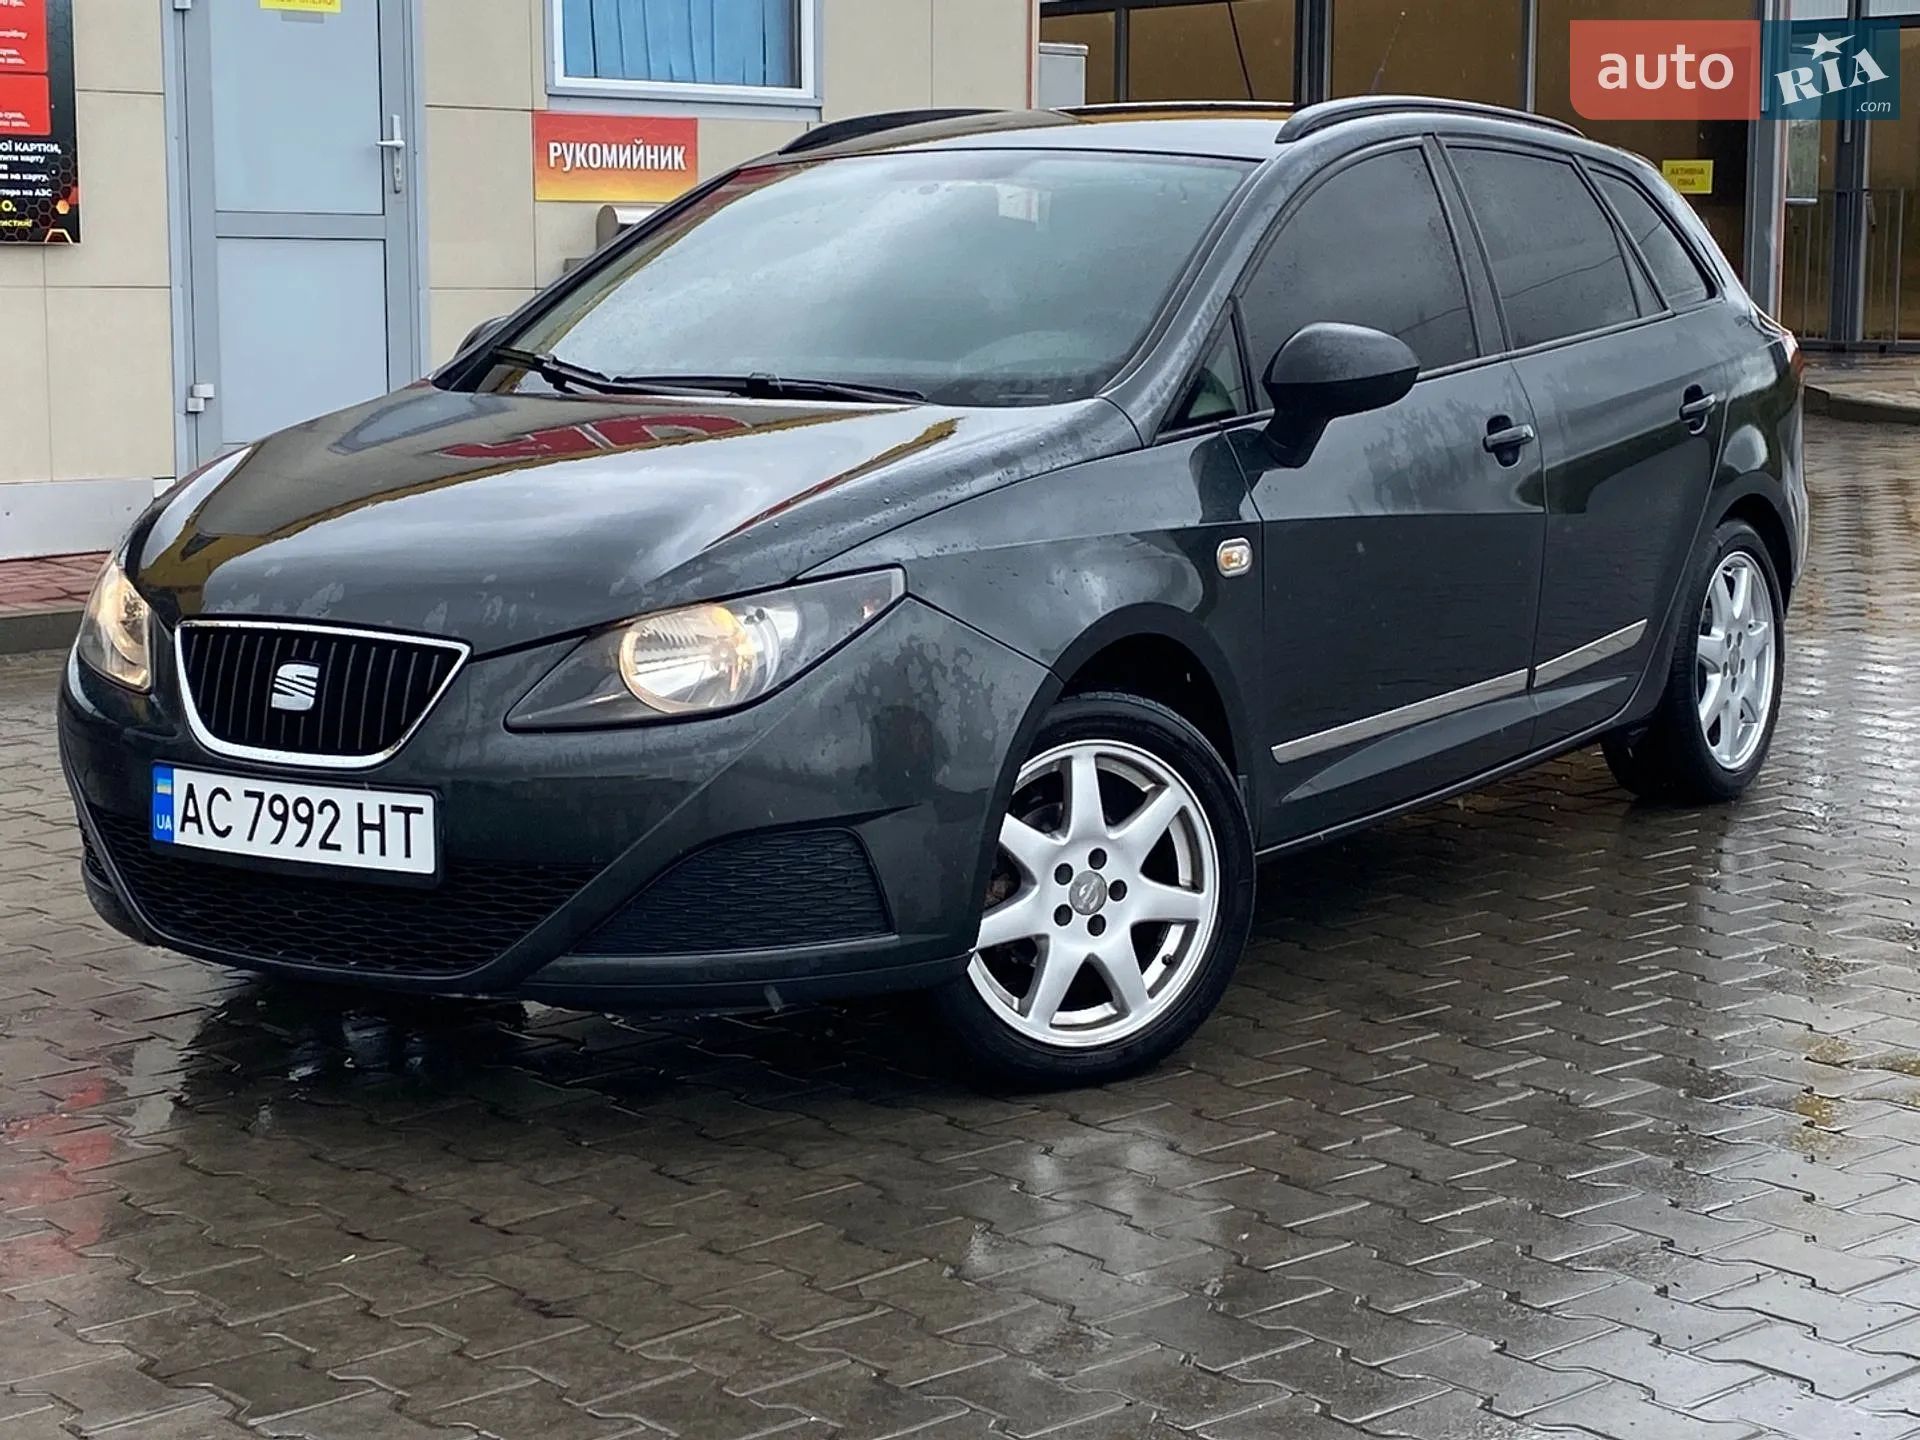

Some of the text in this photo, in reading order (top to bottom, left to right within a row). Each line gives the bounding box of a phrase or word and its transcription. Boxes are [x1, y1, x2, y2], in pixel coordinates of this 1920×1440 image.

[549, 138, 687, 172] РУКОМИЙНИК
[156, 813, 172, 831] UA
[179, 783, 424, 859] AC 7992 HT
